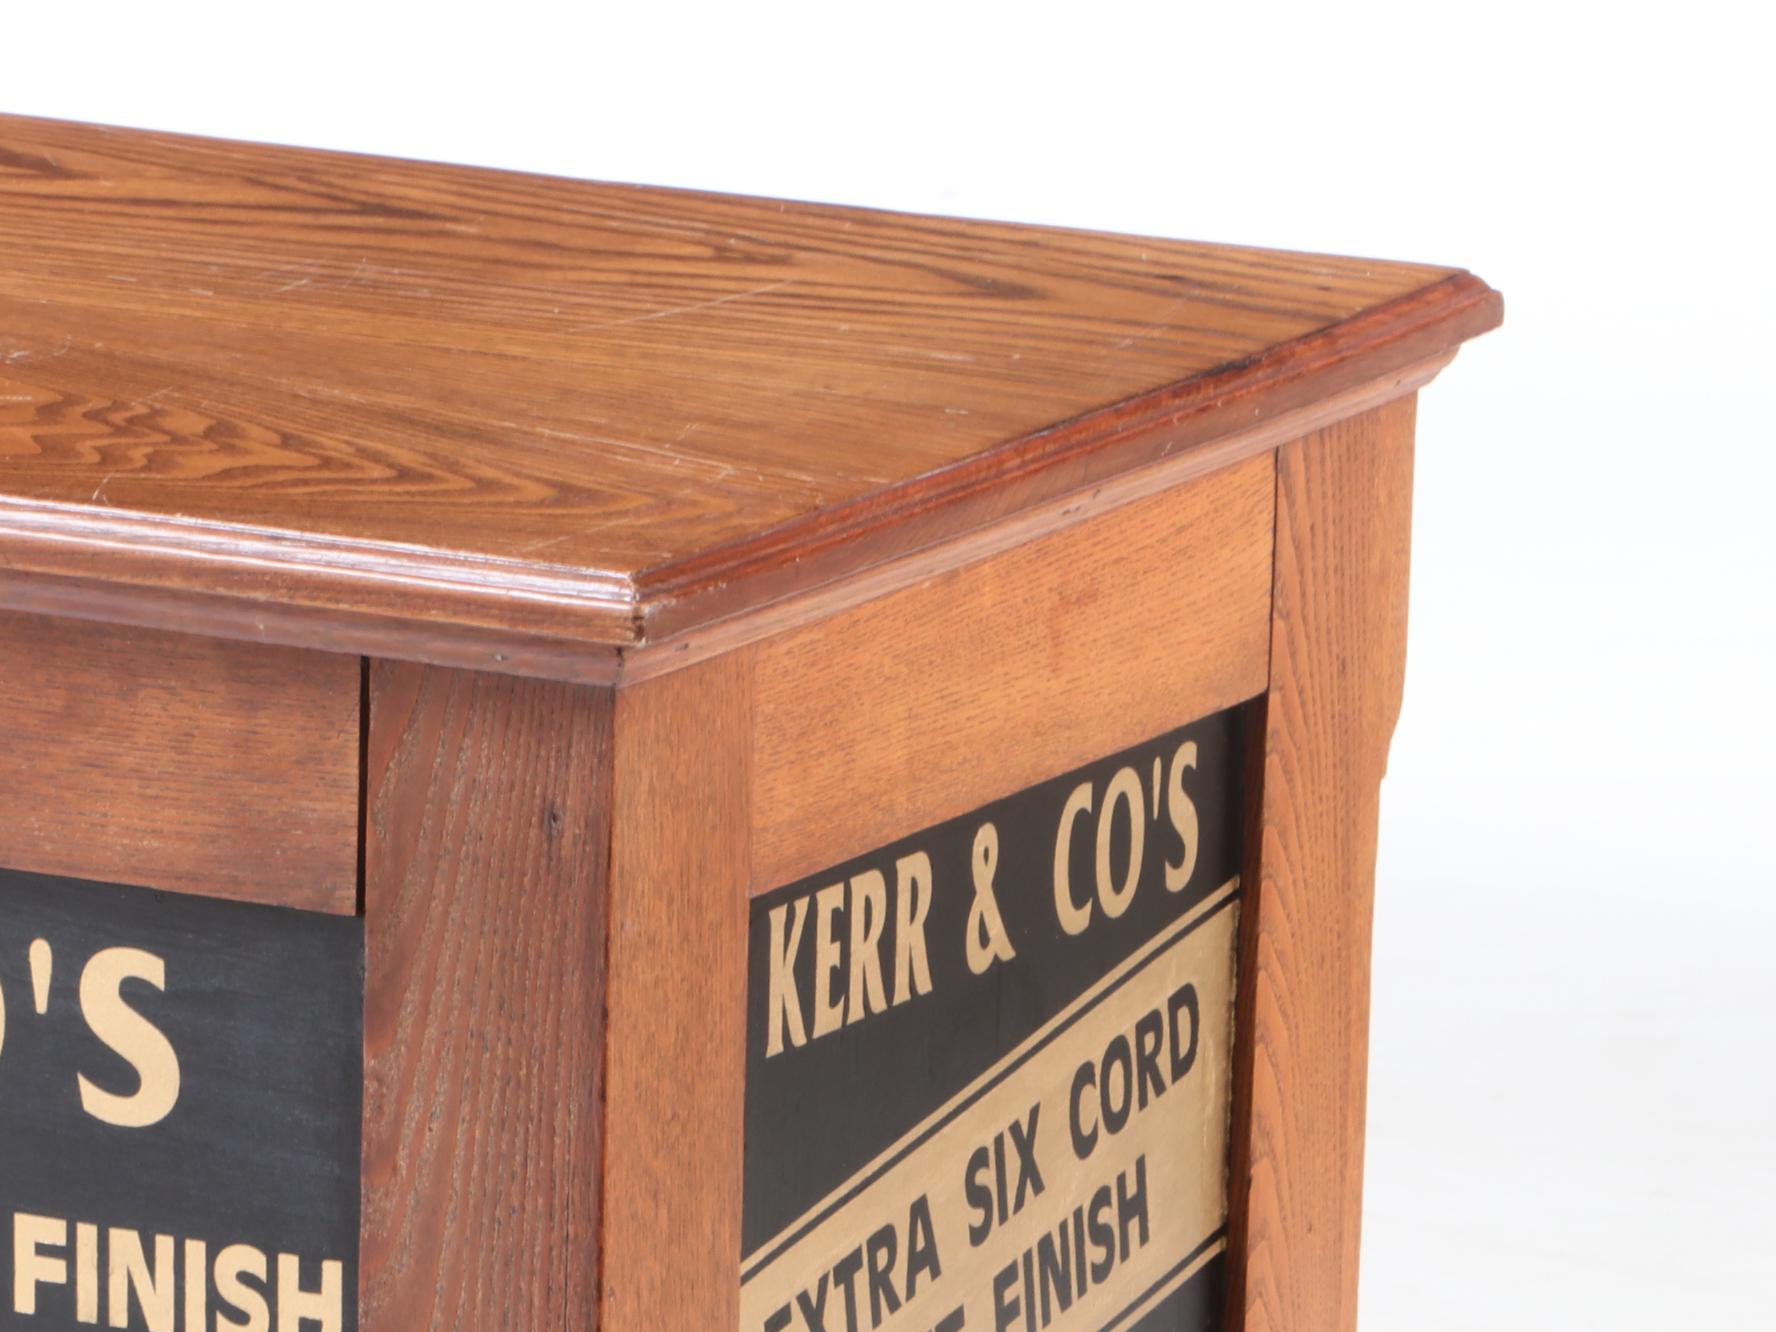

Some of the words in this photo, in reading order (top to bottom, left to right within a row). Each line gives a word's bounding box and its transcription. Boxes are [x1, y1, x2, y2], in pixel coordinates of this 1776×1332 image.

[765, 850, 933, 1059] KERR
[965, 821, 1016, 975] &
[1053, 740, 1199, 936] CO'S
[964, 1103, 1045, 1247] SIX
[1069, 982, 1200, 1159] CORD
